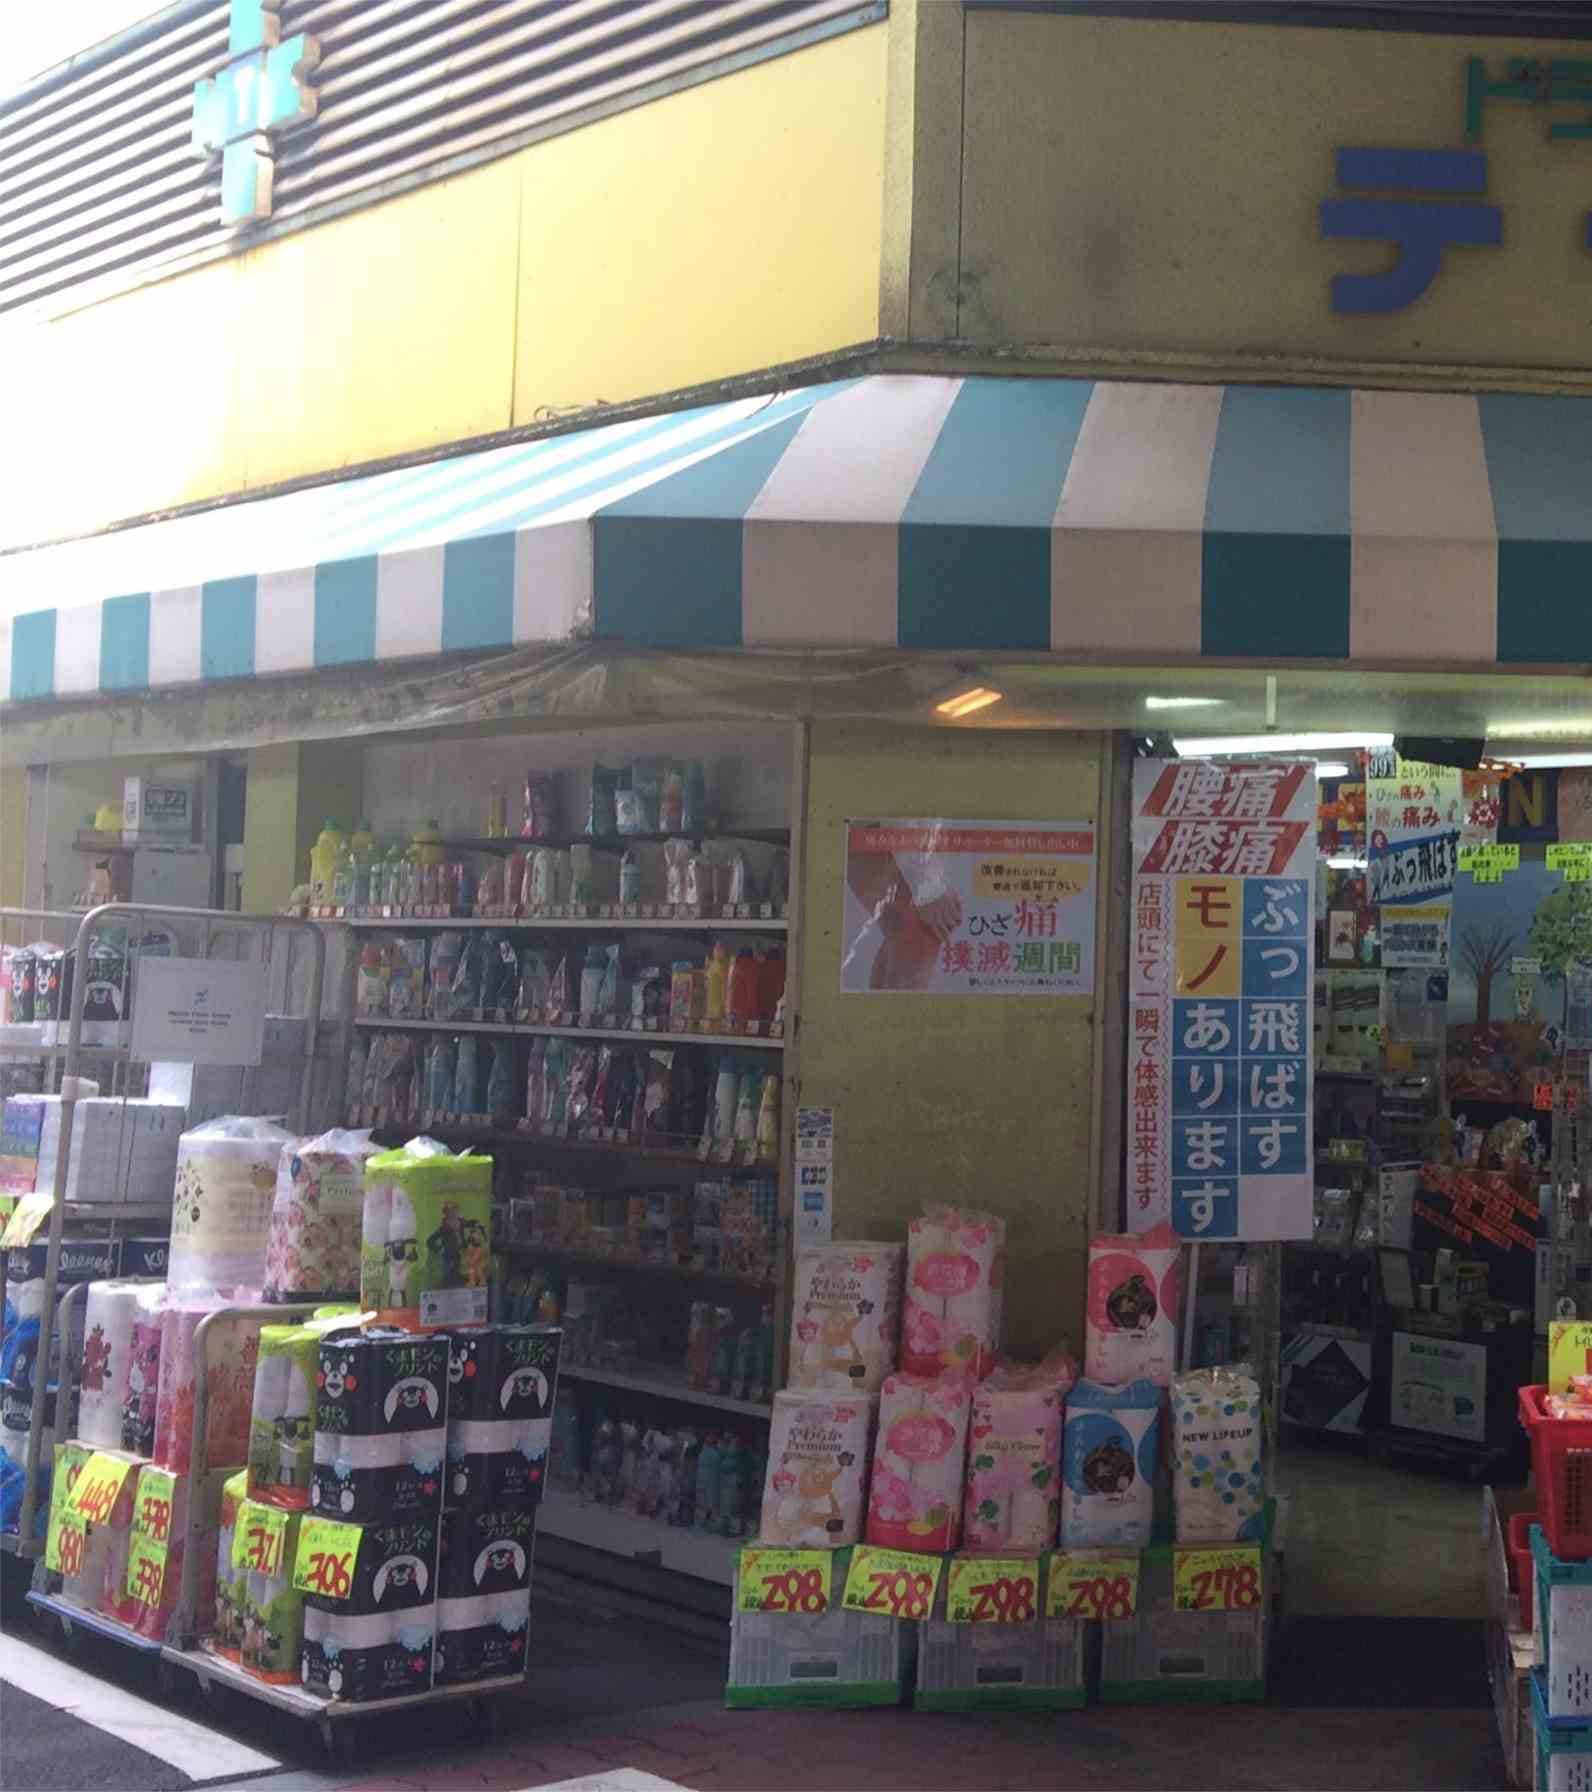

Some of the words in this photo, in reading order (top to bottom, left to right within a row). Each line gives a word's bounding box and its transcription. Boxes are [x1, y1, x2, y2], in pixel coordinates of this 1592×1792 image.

[1161, 763, 1285, 818] 腰痛
[1158, 820, 1283, 875] 膝痛
[1181, 1430, 1209, 1442] NEW
[306, 1552, 353, 1600] 306
[760, 1568, 828, 1612] 298
[863, 1568, 933, 1617] 298
[1068, 1576, 1134, 1618] 298
[1190, 1566, 1260, 1610] 278
[969, 1577, 1035, 1622] 298
